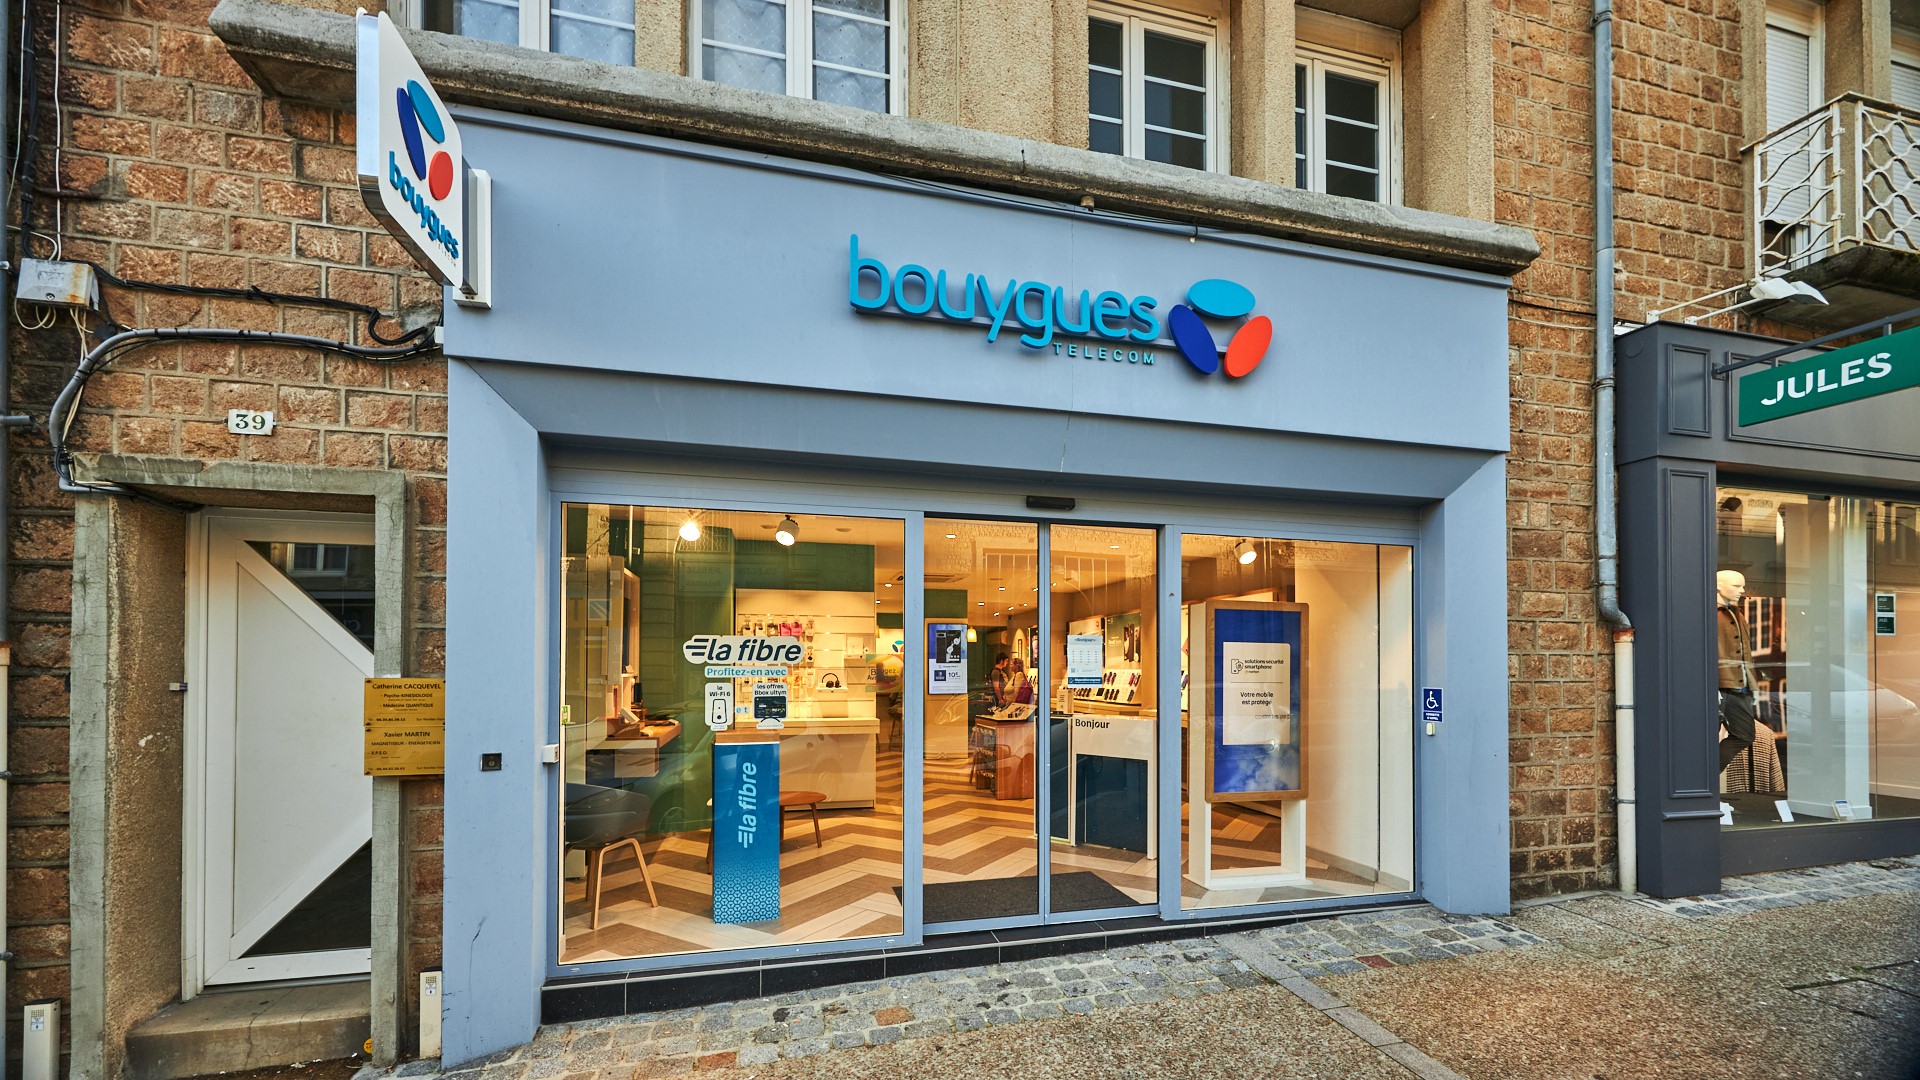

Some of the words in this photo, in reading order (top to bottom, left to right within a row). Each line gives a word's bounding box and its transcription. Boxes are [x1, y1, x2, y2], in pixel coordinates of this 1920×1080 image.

[389, 151, 459, 259] bouygues
[849, 233, 1161, 349] bouygues
[1053, 341, 1156, 365] TELECOM
[1760, 352, 1893, 406] JULES
[235, 413, 266, 430] 39
[707, 638, 732, 661] la
[737, 638, 802, 662] fibre
[706, 667, 763, 676] Profitez-en
[764, 668, 787, 676] avec
[1075, 718, 1110, 730] Bonjour
[737, 762, 757, 811] fibre
[738, 813, 757, 833] la
